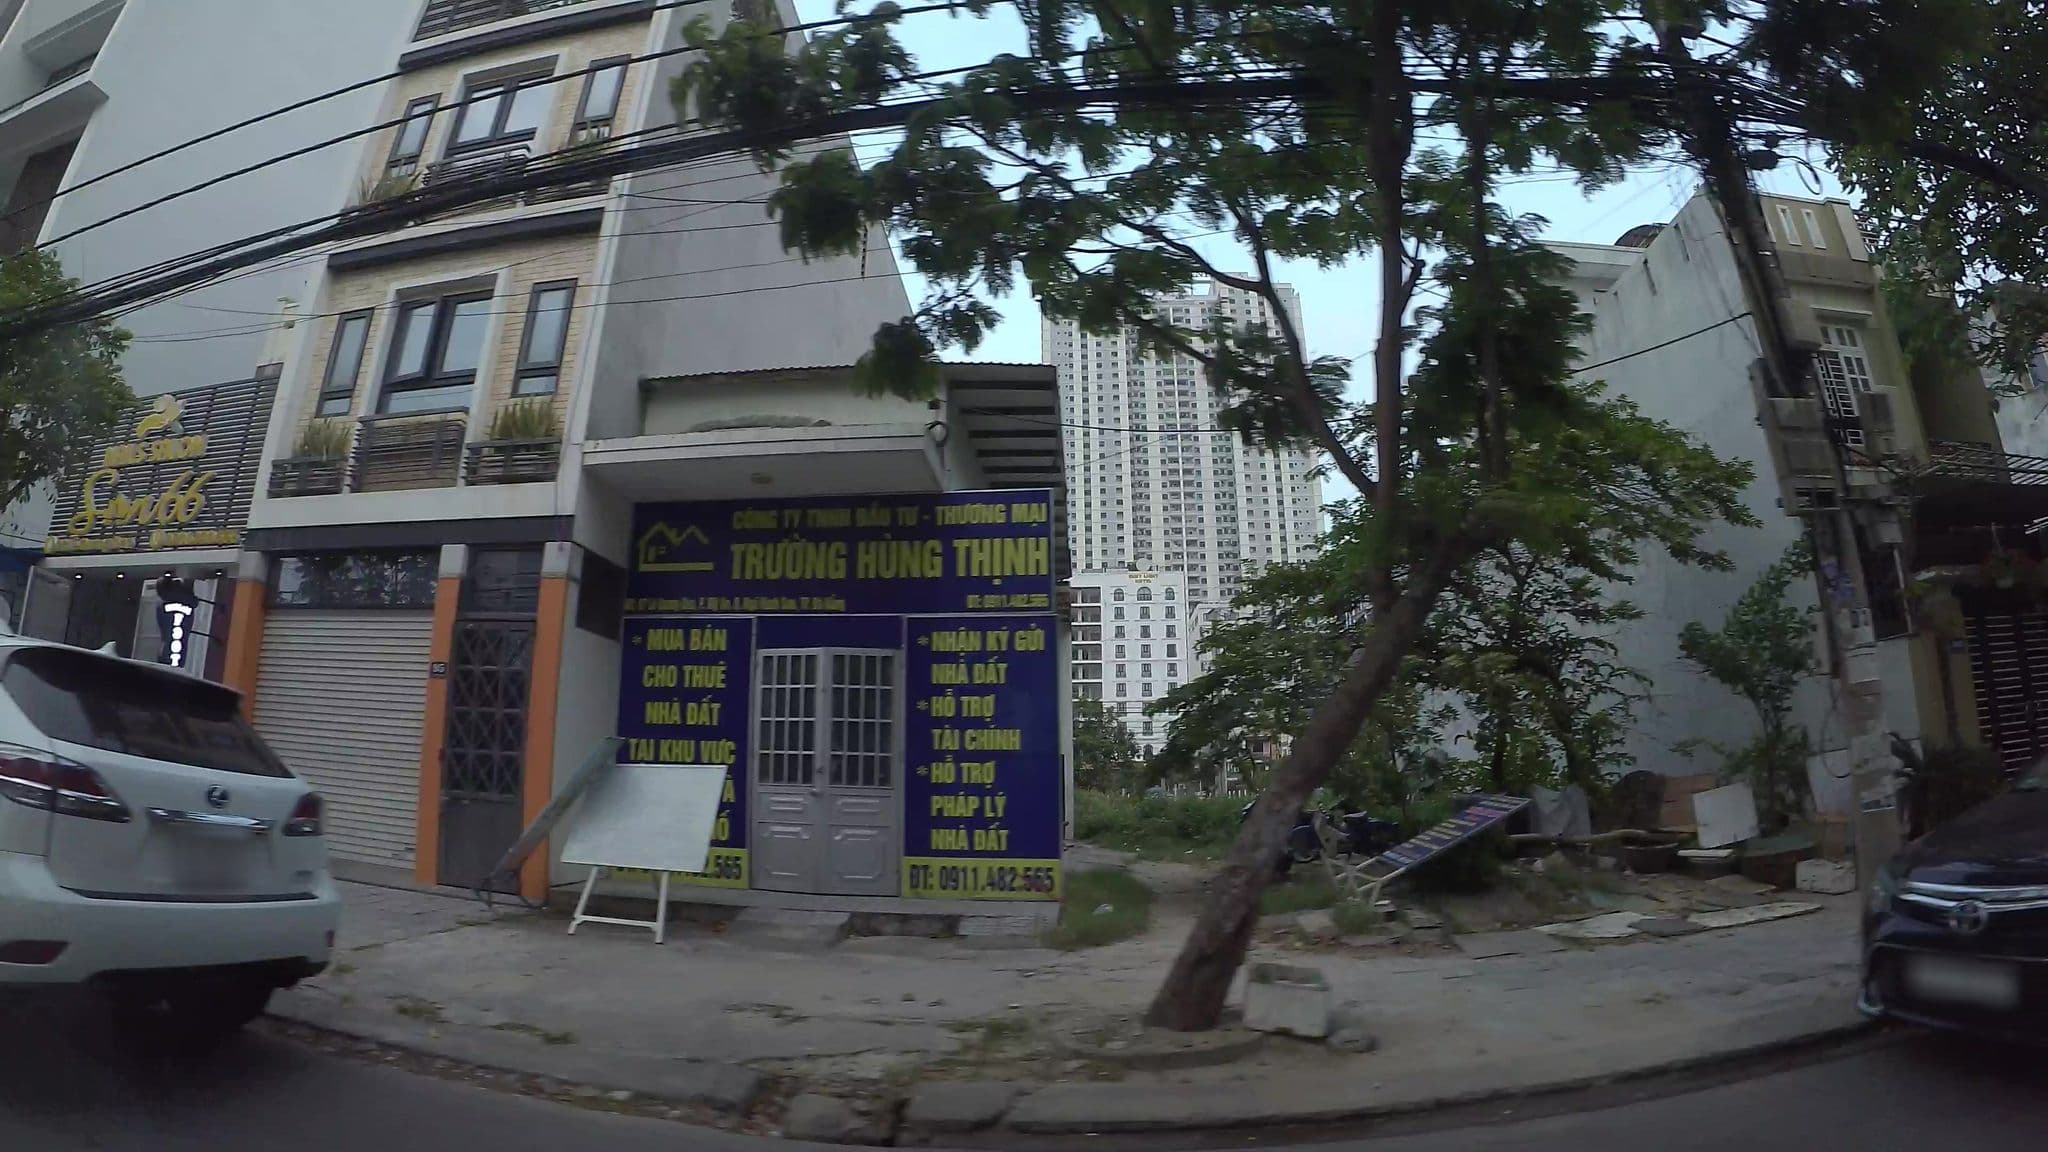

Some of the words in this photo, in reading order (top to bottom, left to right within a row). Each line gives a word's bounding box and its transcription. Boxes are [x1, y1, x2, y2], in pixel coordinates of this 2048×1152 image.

[953, 537, 1048, 585] THỊNH
[647, 629, 685, 651] MUA
[690, 625, 727, 651] BÁN
[643, 664, 678, 688] CHO
[682, 660, 727, 688] THUÊ
[931, 658, 969, 684] NHÀ
[973, 656, 1008, 684] ĐẤT
[645, 697, 681, 724] NHÀ
[686, 695, 721, 726] ĐẤT
[960, 694, 996, 722] TRỢ
[660, 739, 695, 762] KHU
[931, 724, 960, 750] TÀI
[964, 724, 1021, 750] CHÍNH
[960, 761, 996, 789] TRỢ
[930, 791, 980, 817] PHÁP
[984, 791, 1007, 817] LÝ
[930, 824, 969, 850] NHÀ
[973, 822, 1009, 850] ĐẤT
